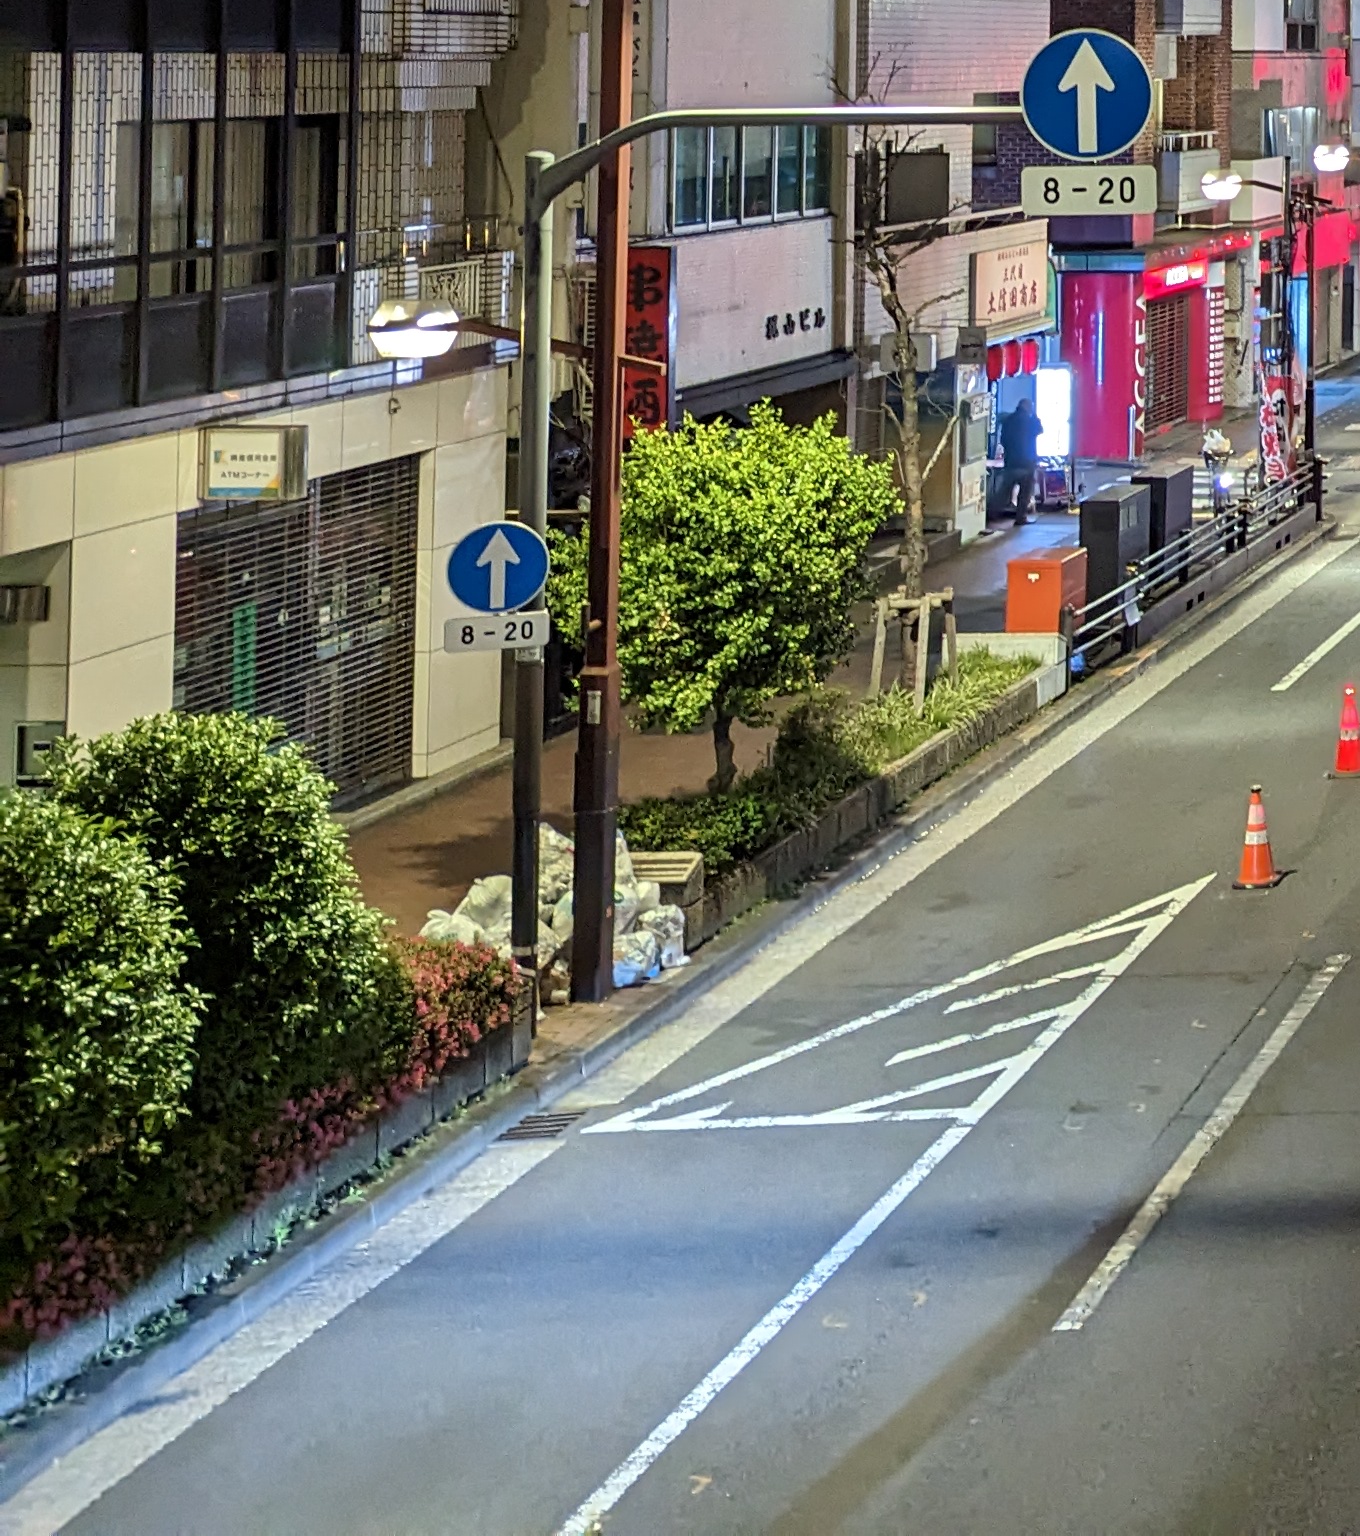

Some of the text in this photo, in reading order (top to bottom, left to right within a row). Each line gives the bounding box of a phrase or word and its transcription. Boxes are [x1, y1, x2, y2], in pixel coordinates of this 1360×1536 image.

[1043, 176, 1136, 205] 8-20
[220, 470, 270, 479] ATMコーナー
[461, 620, 533, 645] 8-20
